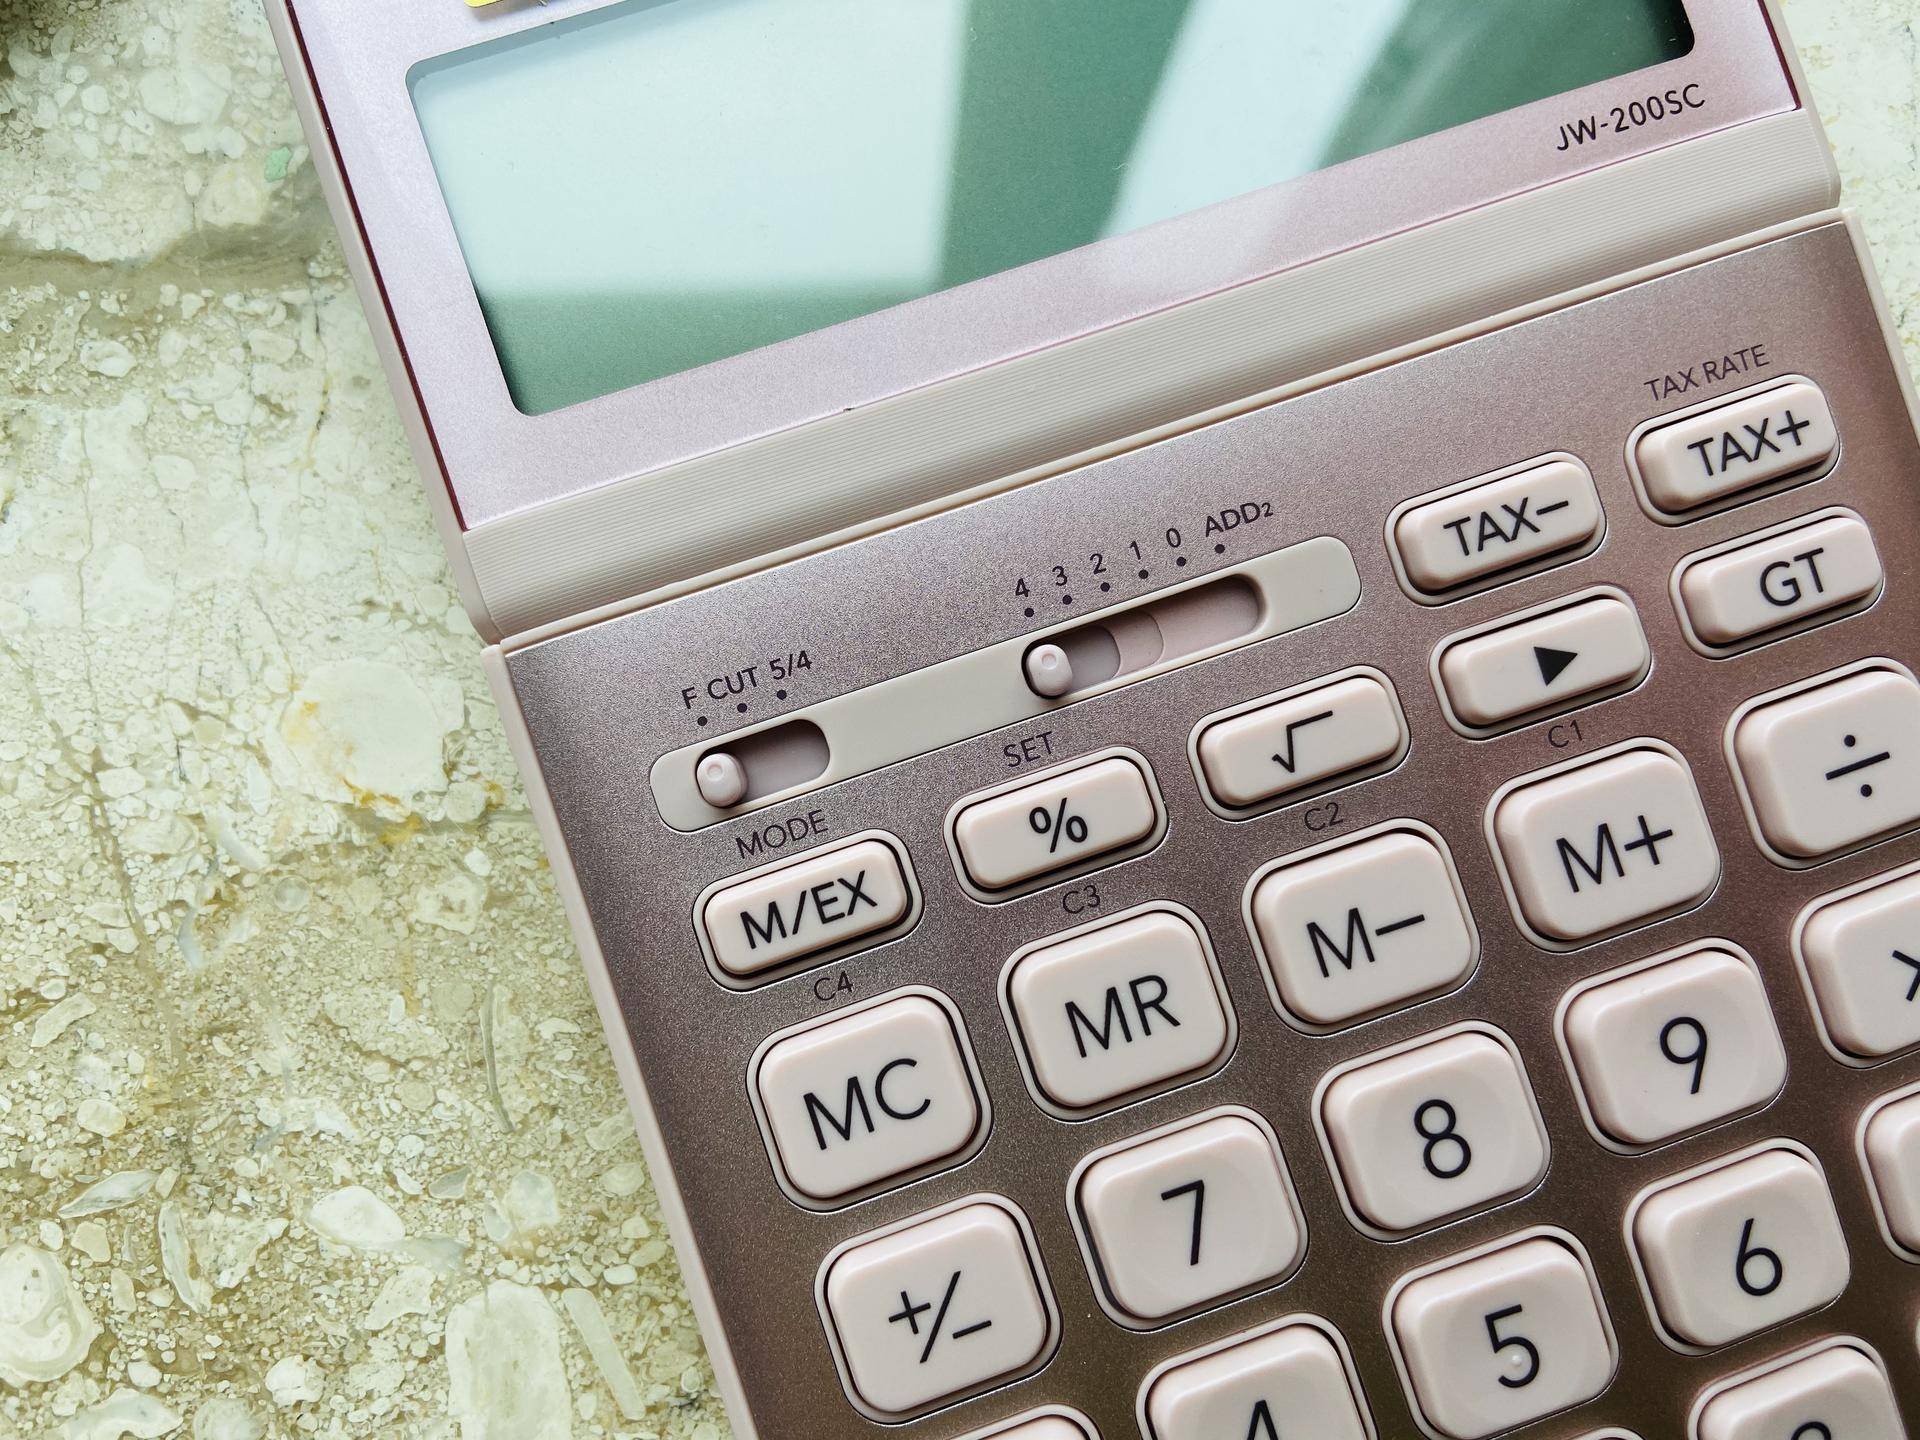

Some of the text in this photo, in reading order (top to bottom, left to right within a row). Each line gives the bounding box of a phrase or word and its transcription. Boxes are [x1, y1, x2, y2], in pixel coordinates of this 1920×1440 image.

[1555, 82, 1706, 152] JW-200SC
[1643, 344, 1771, 402] TAX RATE
[1687, 409, 1811, 478] TAX+
[1014, 577, 1031, 599] 4
[1051, 565, 1069, 587] 3
[1089, 553, 1107, 574] 2
[1128, 540, 1143, 561] 1
[1165, 527, 1182, 548] 0
[1758, 547, 1826, 608] GT
[681, 650, 813, 710] F CUT 5/4
[1001, 730, 1059, 770] SET
[1546, 719, 1585, 750] C1
[733, 808, 831, 861] MODE
[1028, 796, 1089, 855] %
[1303, 801, 1345, 832] C2
[1555, 814, 1675, 894] M+
[739, 869, 879, 950] M/EX
[1060, 884, 1101, 916] C3
[812, 970, 855, 1003] C4
[1063, 973, 1182, 1059] MR
[1658, 1015, 1709, 1095] 9
[801, 1057, 932, 1151] MC
[1412, 1098, 1472, 1180] 8
[1159, 1178, 1206, 1267] 7
[1734, 1217, 1784, 1298] 6
[1483, 1303, 1541, 1390] 5
